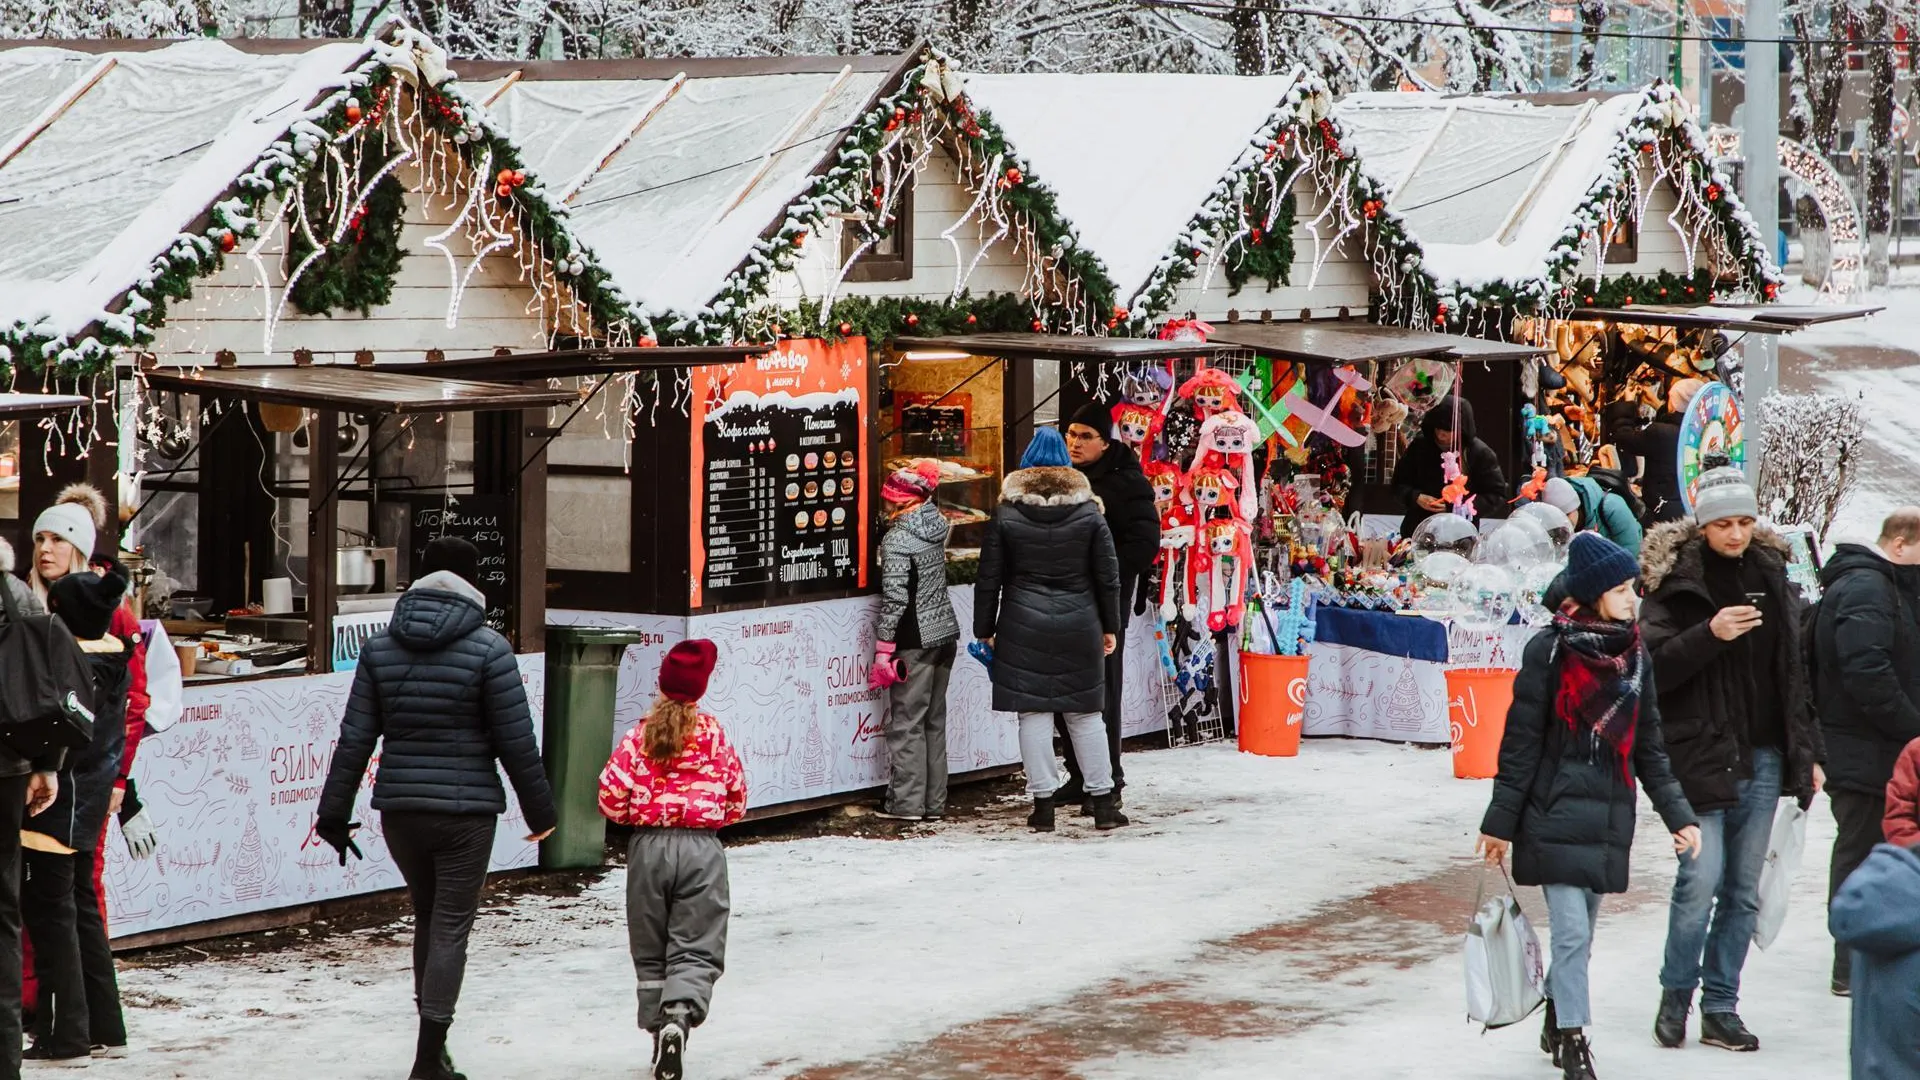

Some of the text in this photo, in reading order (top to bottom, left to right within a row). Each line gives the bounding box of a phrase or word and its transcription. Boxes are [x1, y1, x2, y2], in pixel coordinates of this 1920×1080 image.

[718, 422, 742, 442] Кофе
[748, 420, 770, 436] собой
[804, 416, 836, 430] Пончики
[781, 542, 825, 563] Согревающий
[834, 555, 851, 570] кофе
[784, 558, 818, 582] ГЛИНТВЕЙН
[741, 620, 794, 638] ТЫ ПРИГЛАШЕН!
[827, 654, 869, 690] ЗИМ
[828, 688, 882, 707] В ПОДМОСКОВЬЕ
